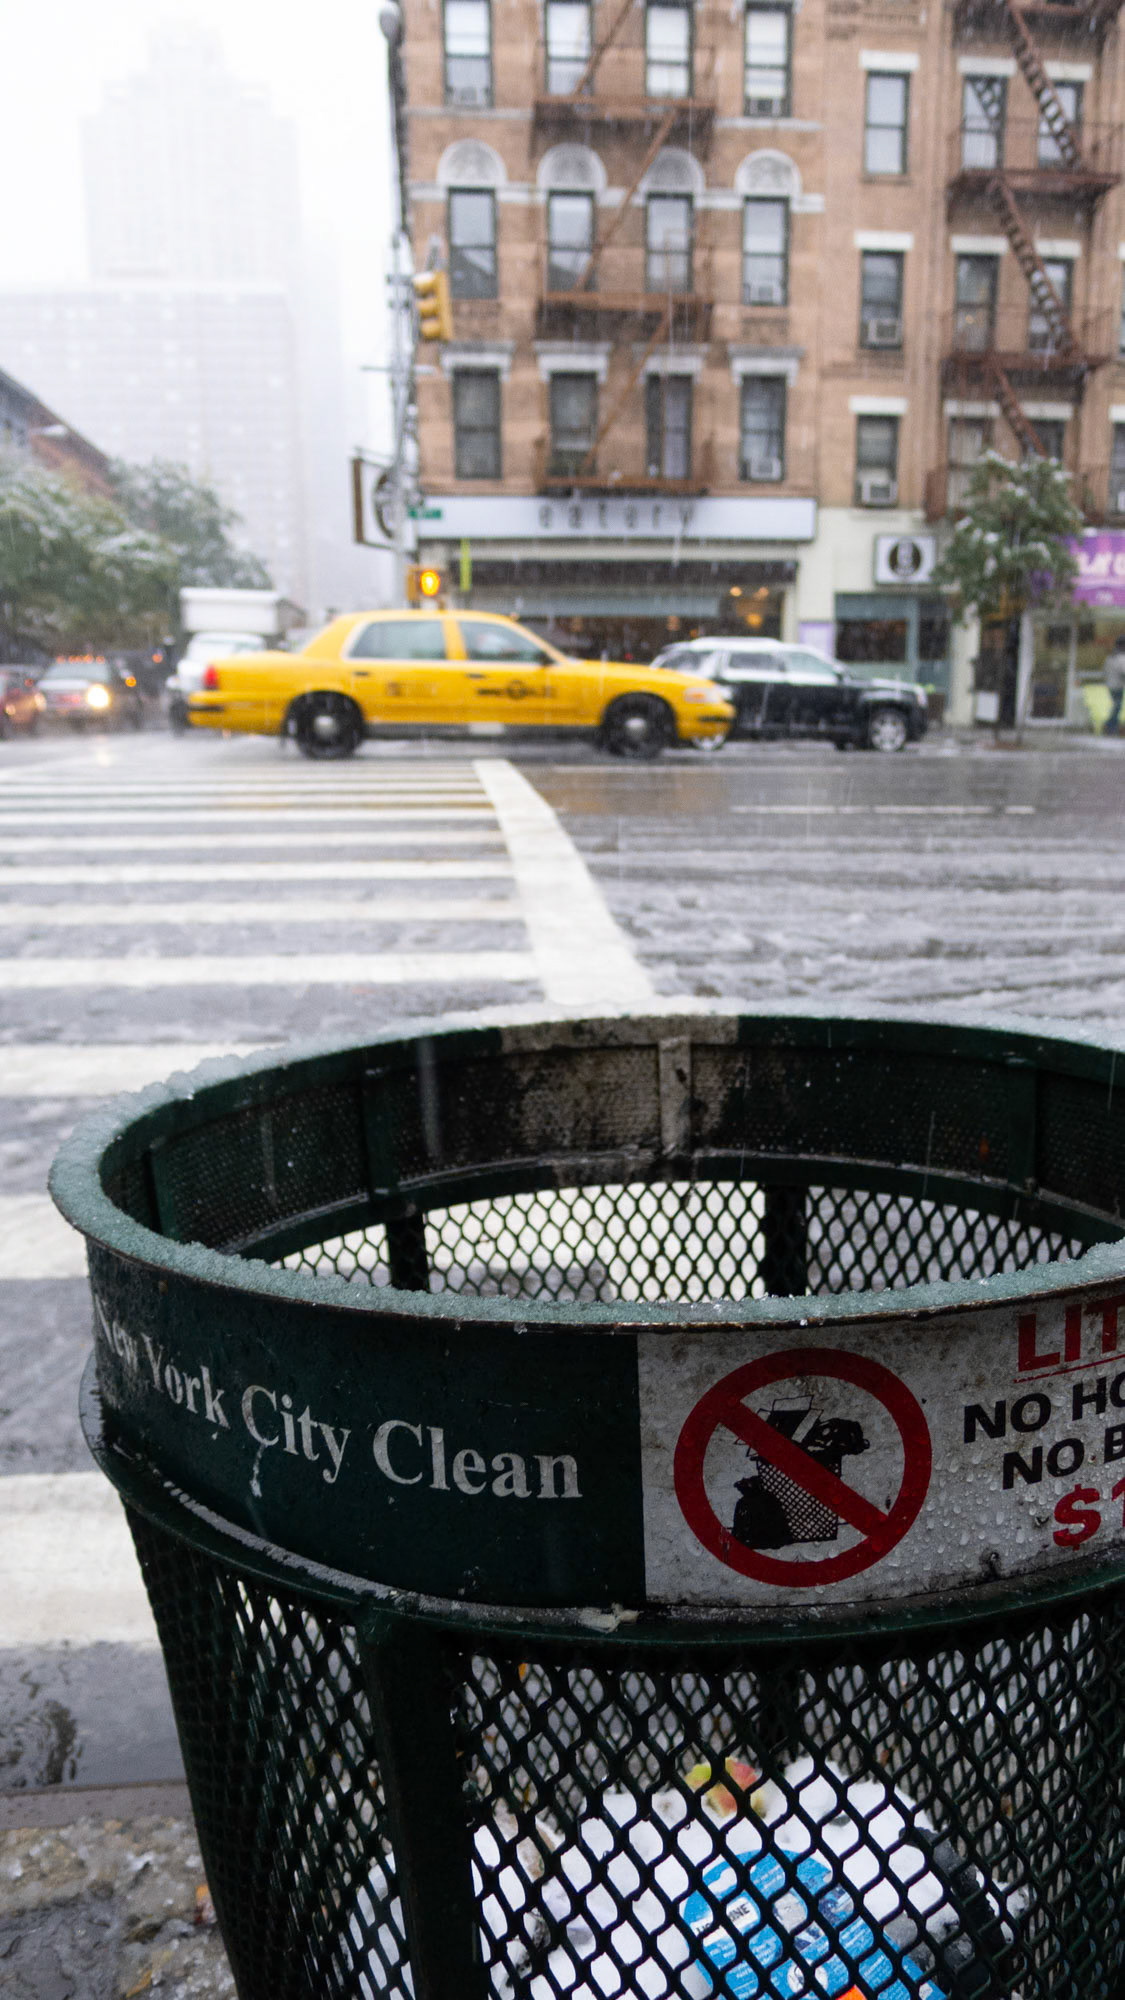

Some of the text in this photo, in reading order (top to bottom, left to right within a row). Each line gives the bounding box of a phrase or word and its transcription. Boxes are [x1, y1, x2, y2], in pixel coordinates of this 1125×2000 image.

[94, 1294, 583, 1499] New York City Clean
[963, 1392, 1052, 1444] NO
[1002, 1437, 1085, 1490] NO
